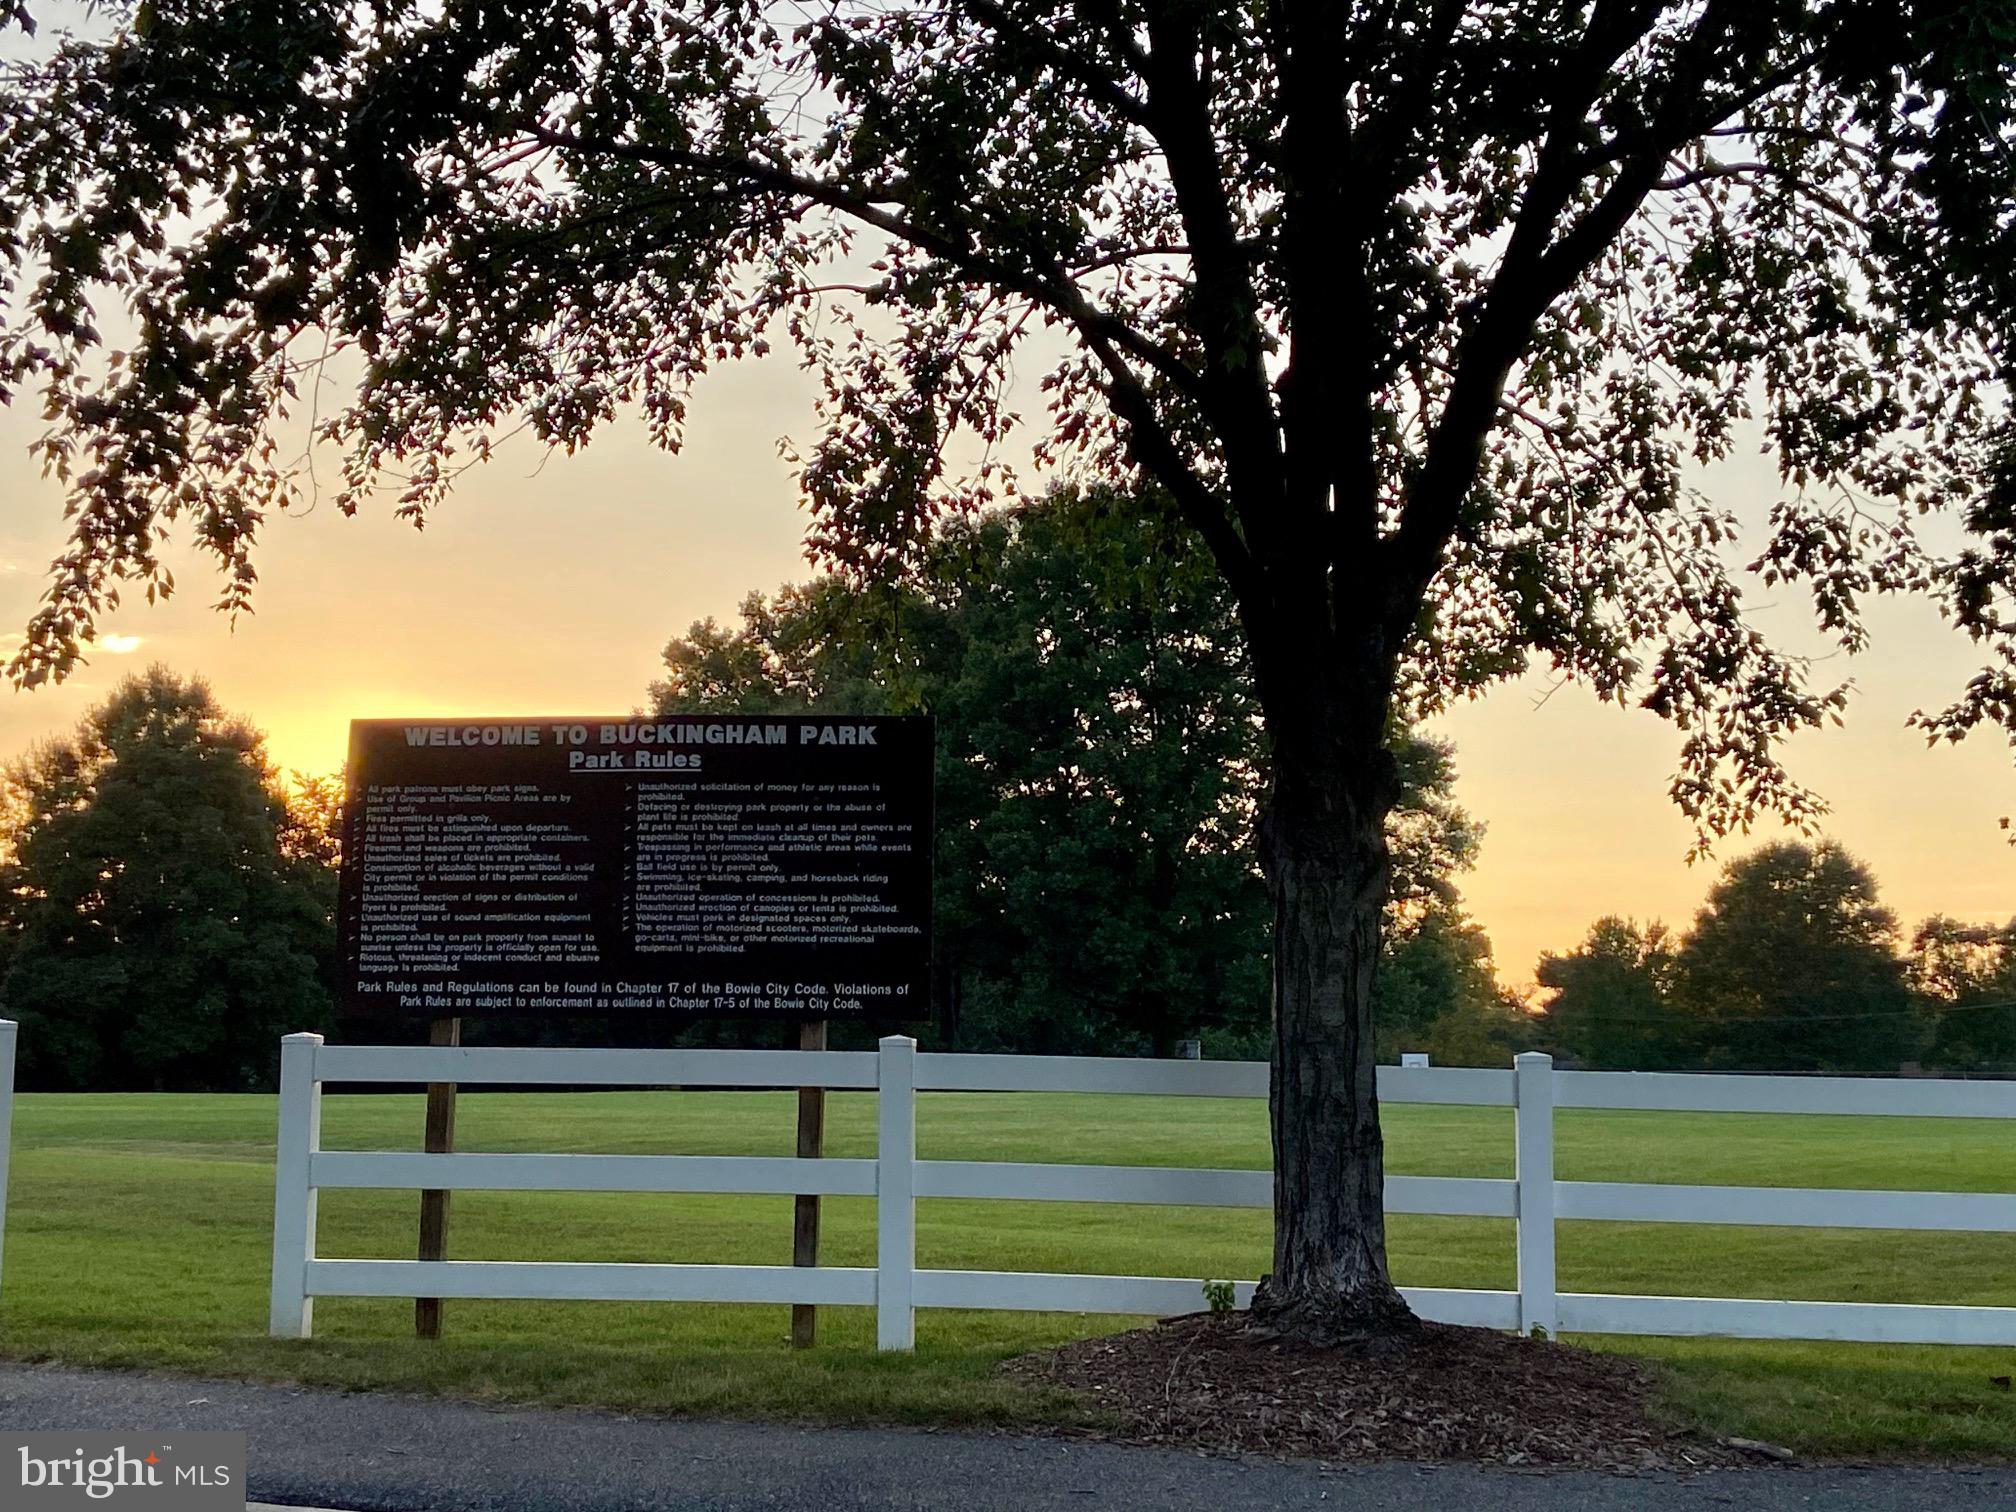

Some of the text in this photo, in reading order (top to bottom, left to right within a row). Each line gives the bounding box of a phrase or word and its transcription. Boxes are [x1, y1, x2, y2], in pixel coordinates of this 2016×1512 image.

[403, 725, 879, 746] WELCOME TO BUCKINGHAM PARK
[567, 751, 704, 769] Park Rules
[356, 981, 910, 996] Park Rules and Regulations can be found in Chapter 17 of the Bowie City Code. Violations of
[399, 996, 864, 1010] Park Rules are subject to enforcement as outlined in Chapter 17-5 of the Bowie City Code.
